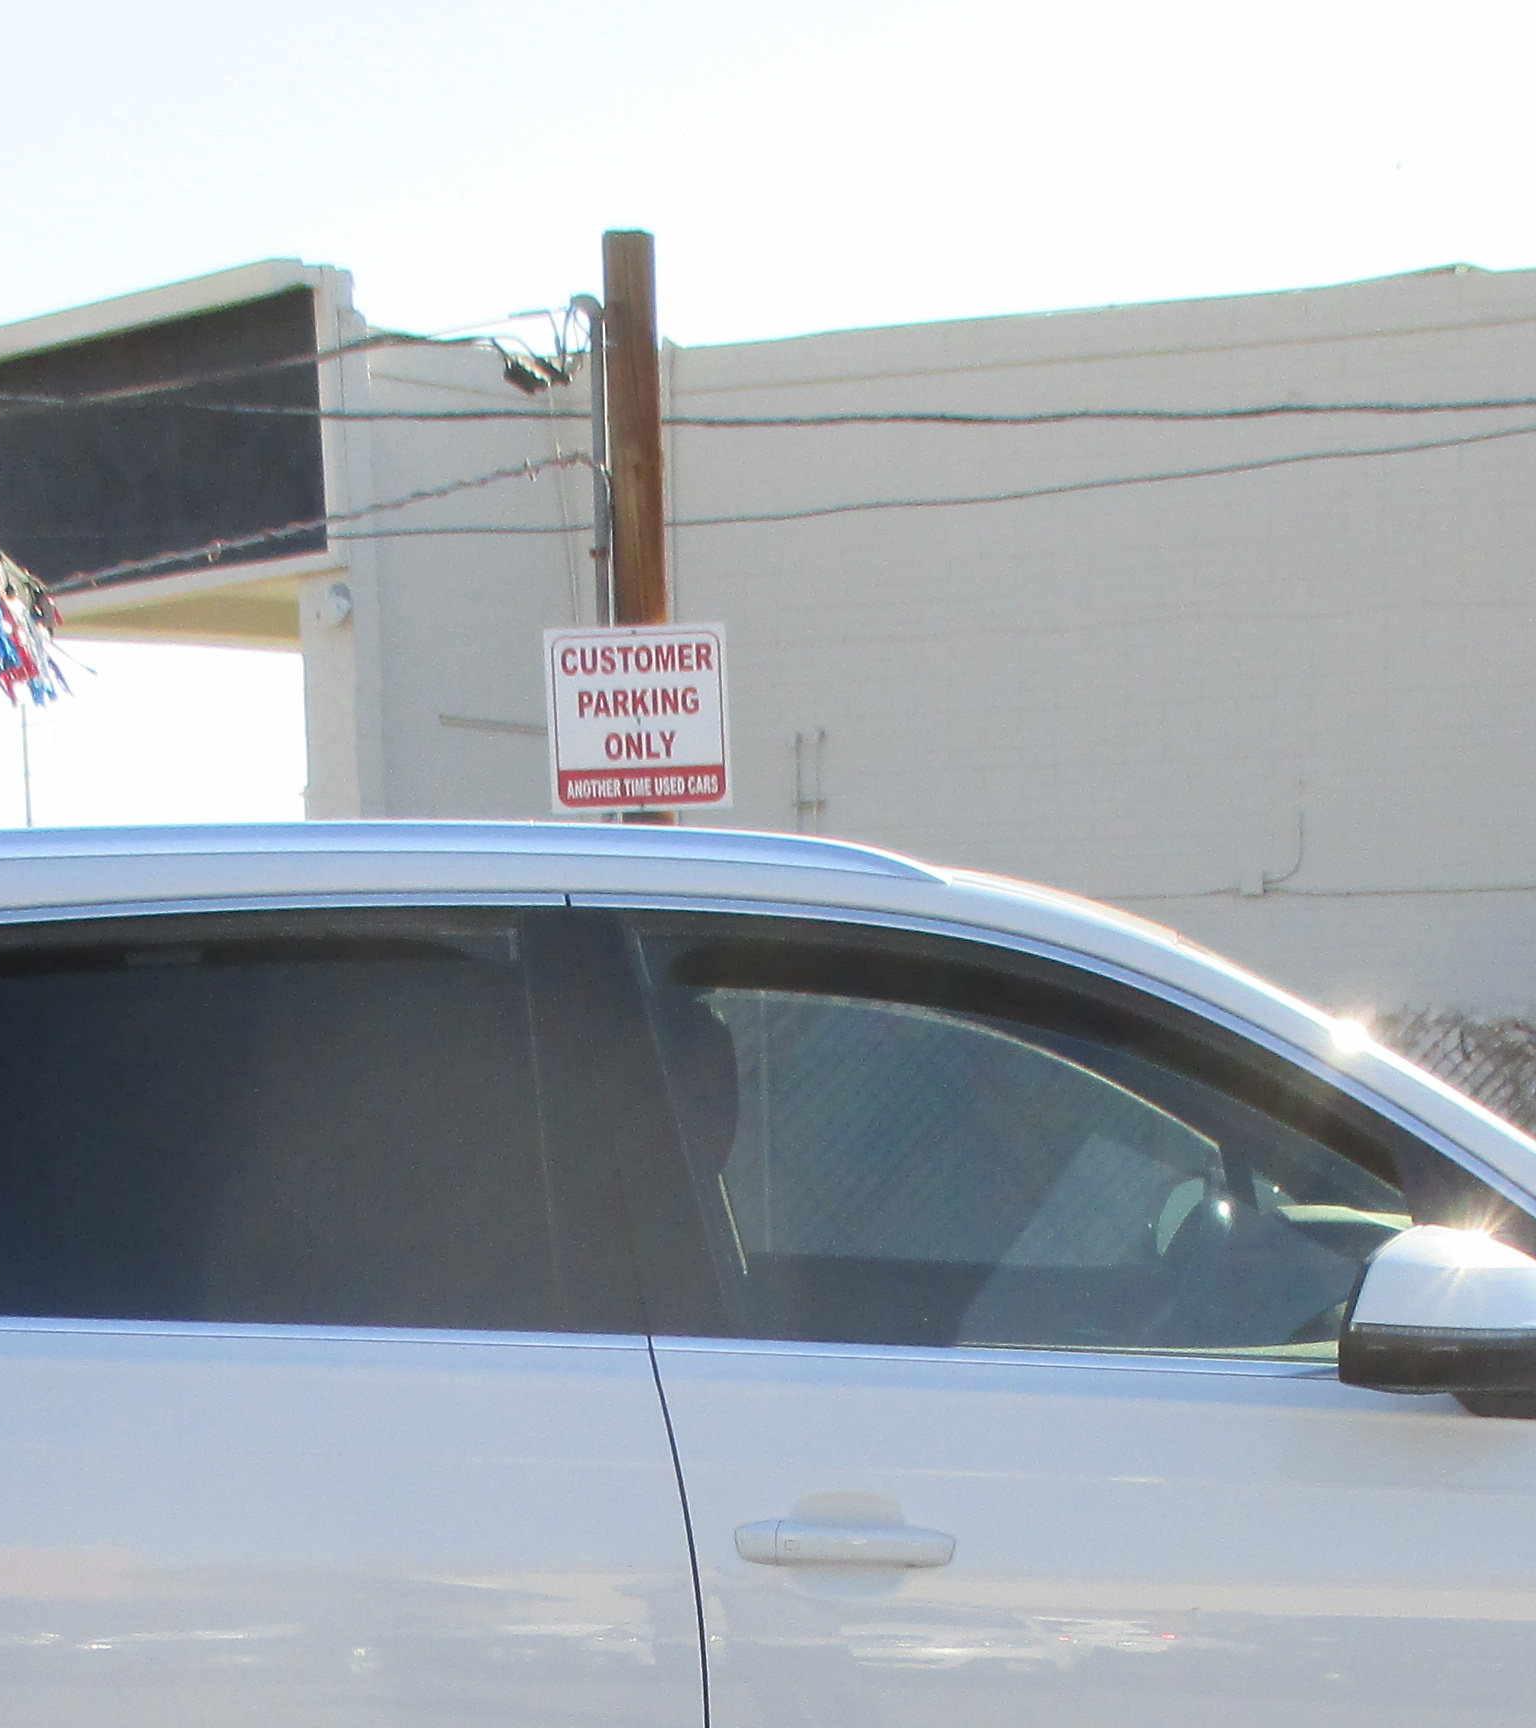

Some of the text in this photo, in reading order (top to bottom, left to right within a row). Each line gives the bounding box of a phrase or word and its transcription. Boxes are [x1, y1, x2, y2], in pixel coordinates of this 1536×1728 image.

[560, 643, 713, 676] CUSTOMER
[577, 686, 700, 719] PARKING
[604, 730, 677, 762] ONLY
[566, 774, 719, 800] ANOTHER TIME USED CARS
